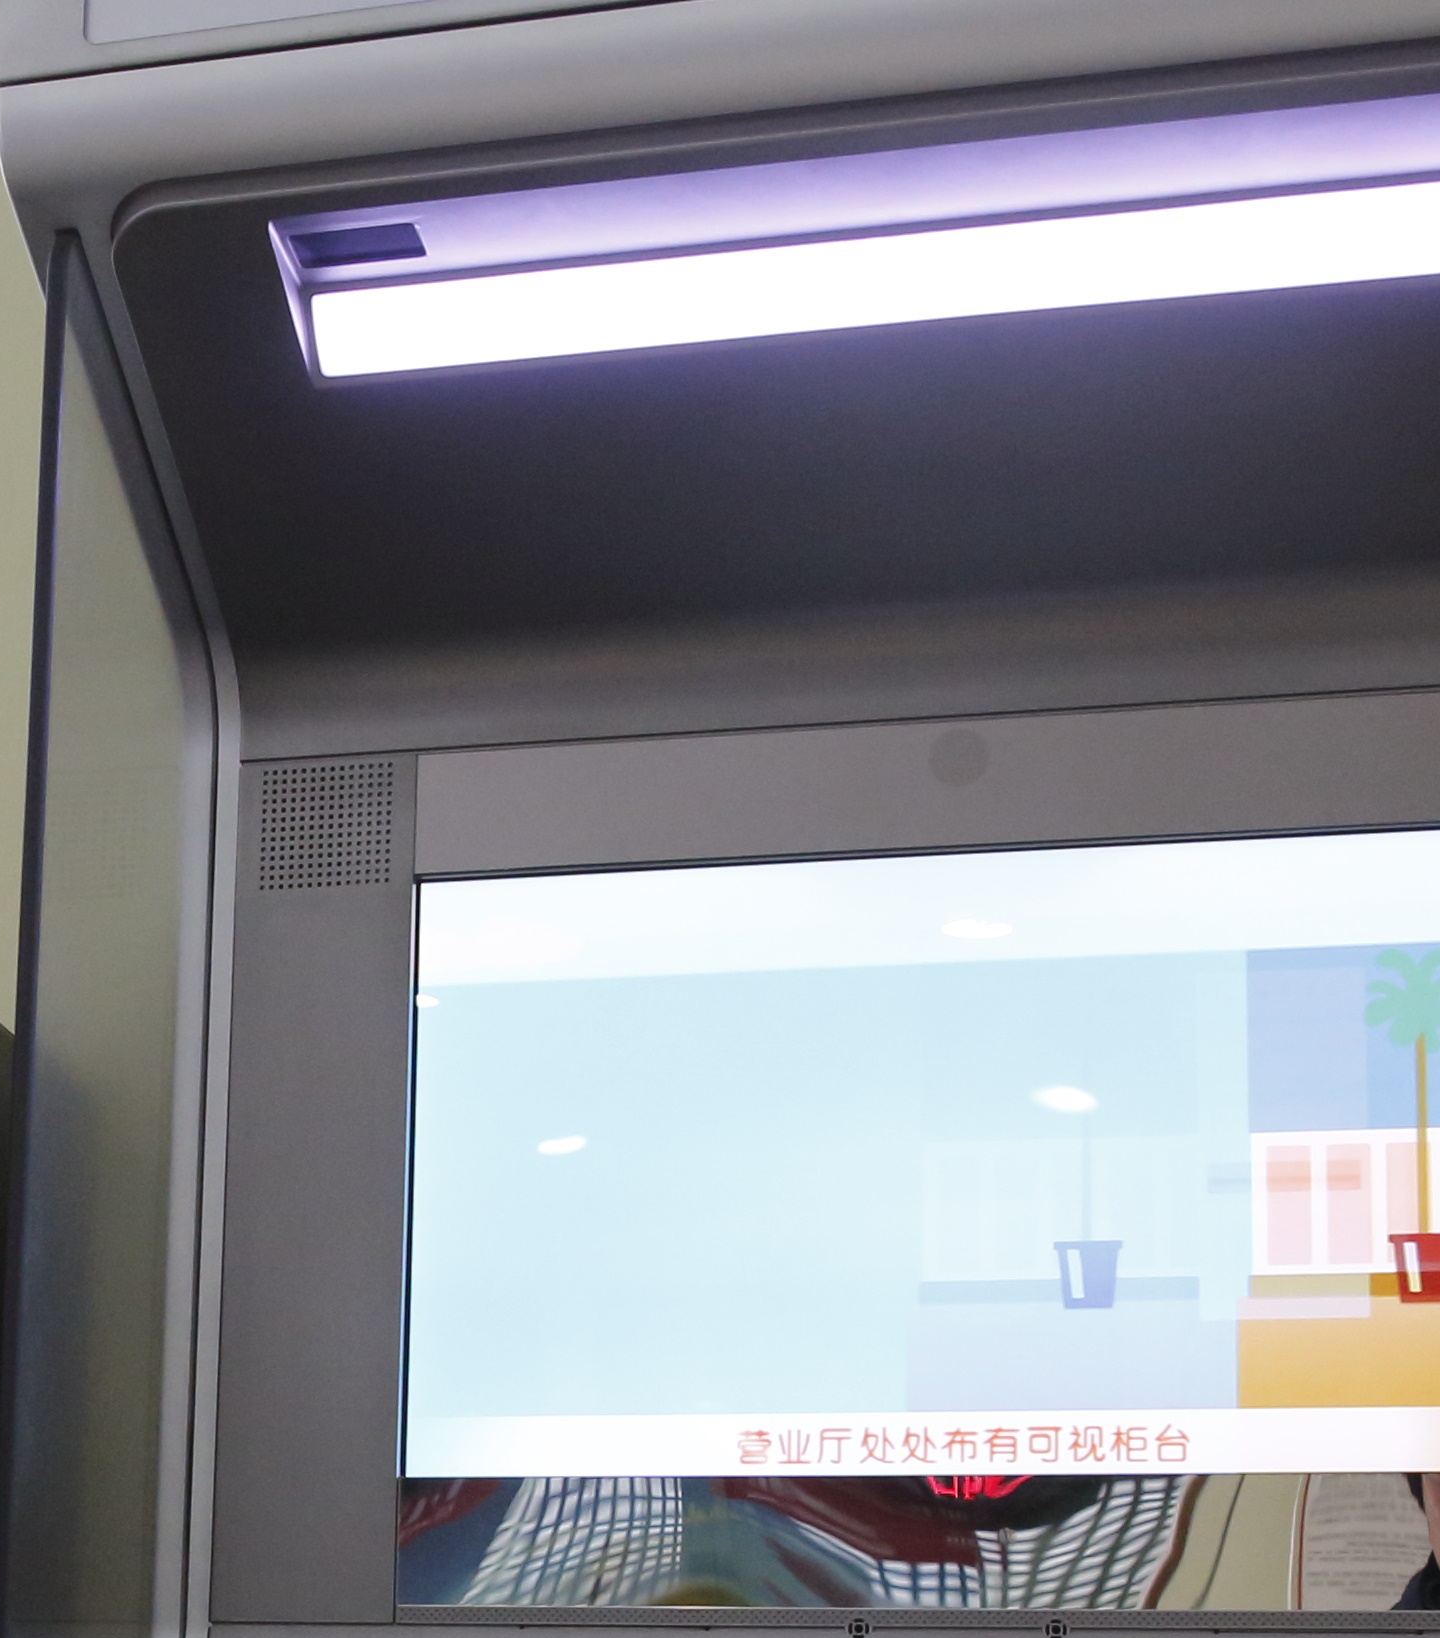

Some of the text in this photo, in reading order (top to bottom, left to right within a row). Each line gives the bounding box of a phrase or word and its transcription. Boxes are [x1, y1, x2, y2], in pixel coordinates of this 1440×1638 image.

[736, 1423, 1191, 1466] 营业厅处处布有可视柜台
